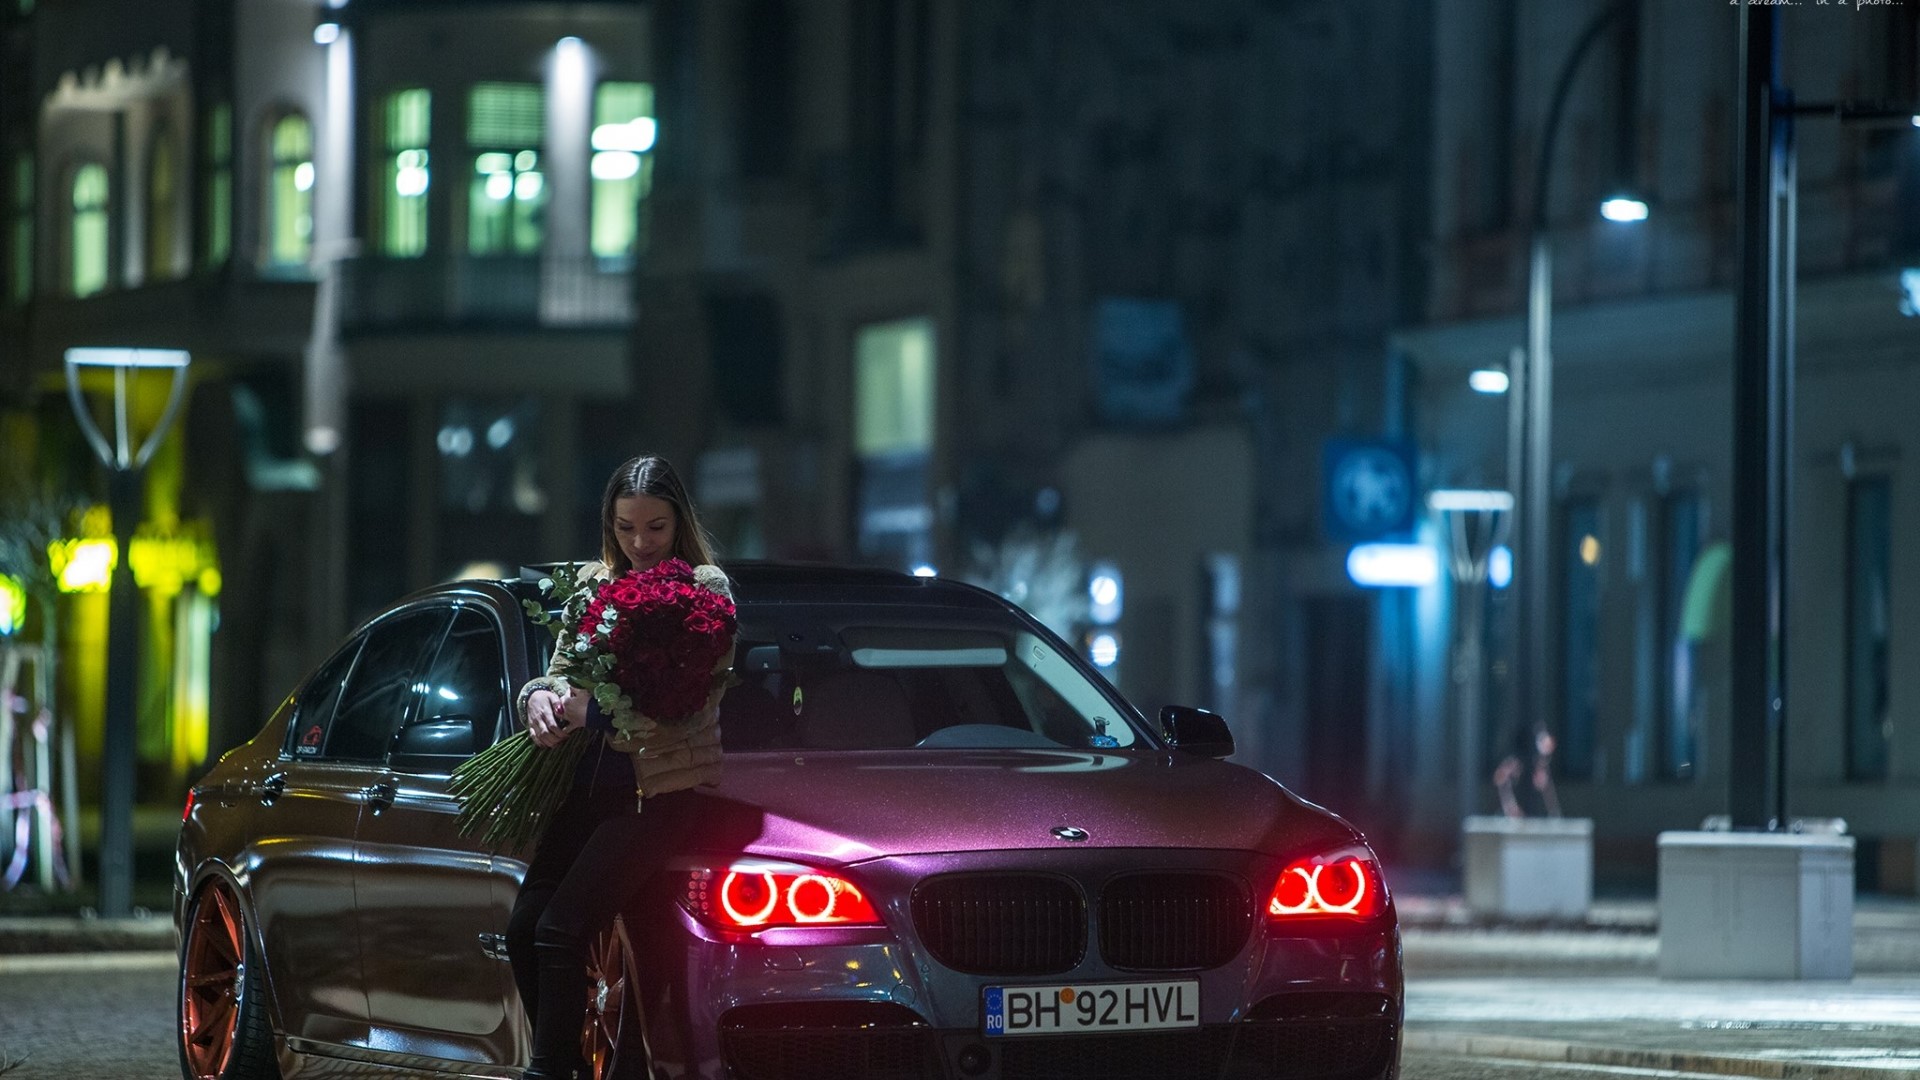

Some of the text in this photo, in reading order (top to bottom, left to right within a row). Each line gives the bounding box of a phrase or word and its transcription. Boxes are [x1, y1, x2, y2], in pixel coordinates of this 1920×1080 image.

[987, 1014, 1003, 1029] RO
[1008, 986, 1195, 1029] BH 92 HVL
